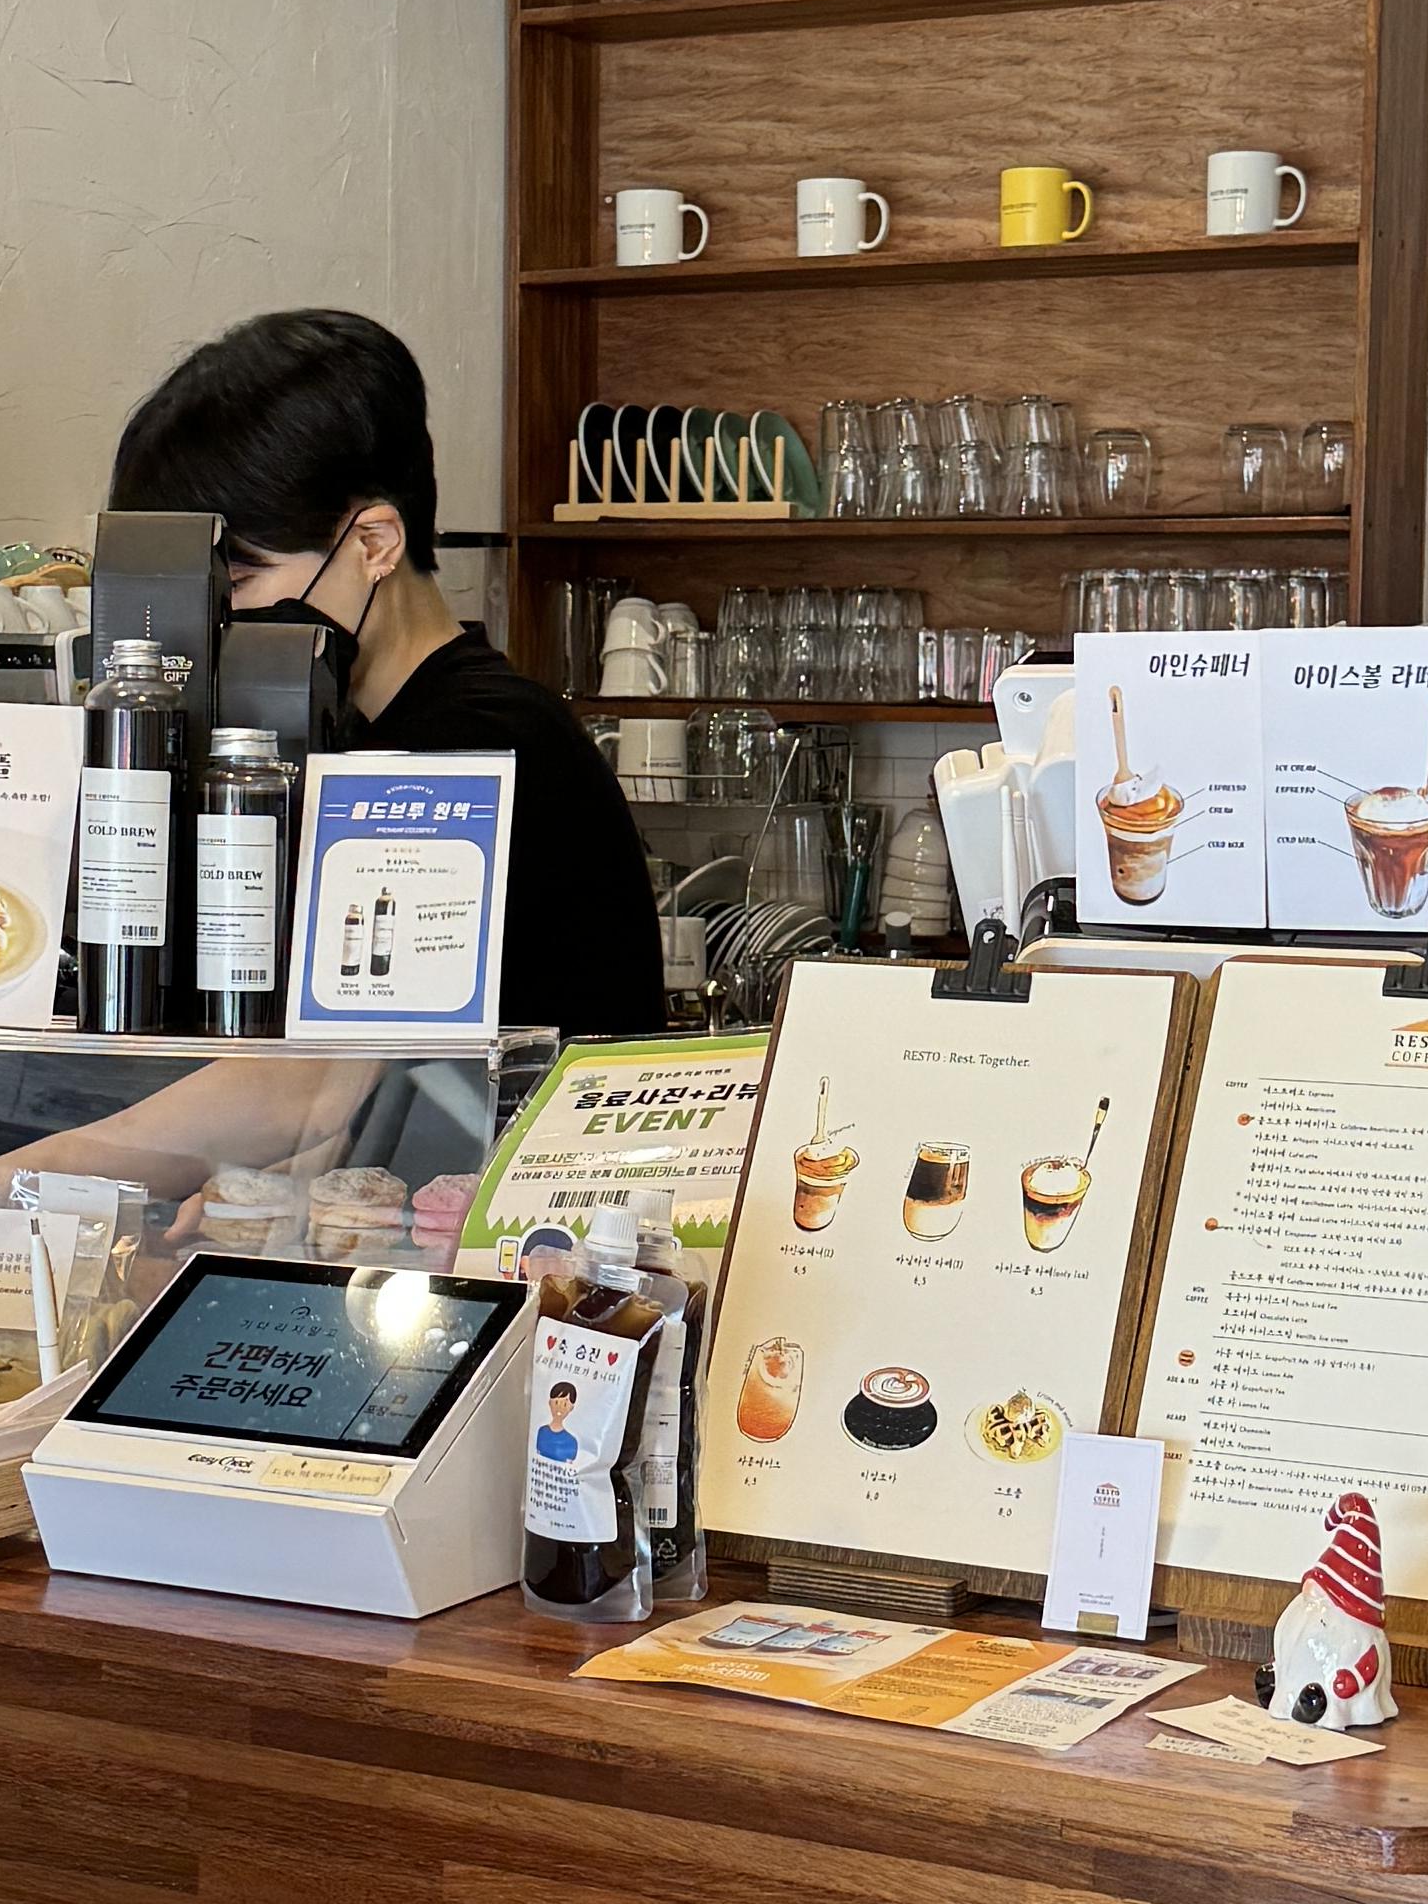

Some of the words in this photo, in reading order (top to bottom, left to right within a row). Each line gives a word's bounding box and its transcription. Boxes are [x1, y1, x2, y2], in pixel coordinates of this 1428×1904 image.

[163, 670, 191, 683] GIFT
[1148, 653, 1251, 679] 아인슈페너
[1293, 663, 1383, 690] 아이스볼
[433, 801, 472, 822] 원액
[87, 824, 118, 837] COLD
[120, 825, 158, 838] BREW
[227, 870, 264, 881] BREW
[902, 1049, 942, 1062] RESTO
[978, 1053, 1031, 1069] Together.
[582, 1106, 726, 1136] EVENT
[204, 1339, 332, 1380] 간편하게
[575, 1344, 603, 1365] 승진
[169, 1372, 314, 1409] 주문하세요
